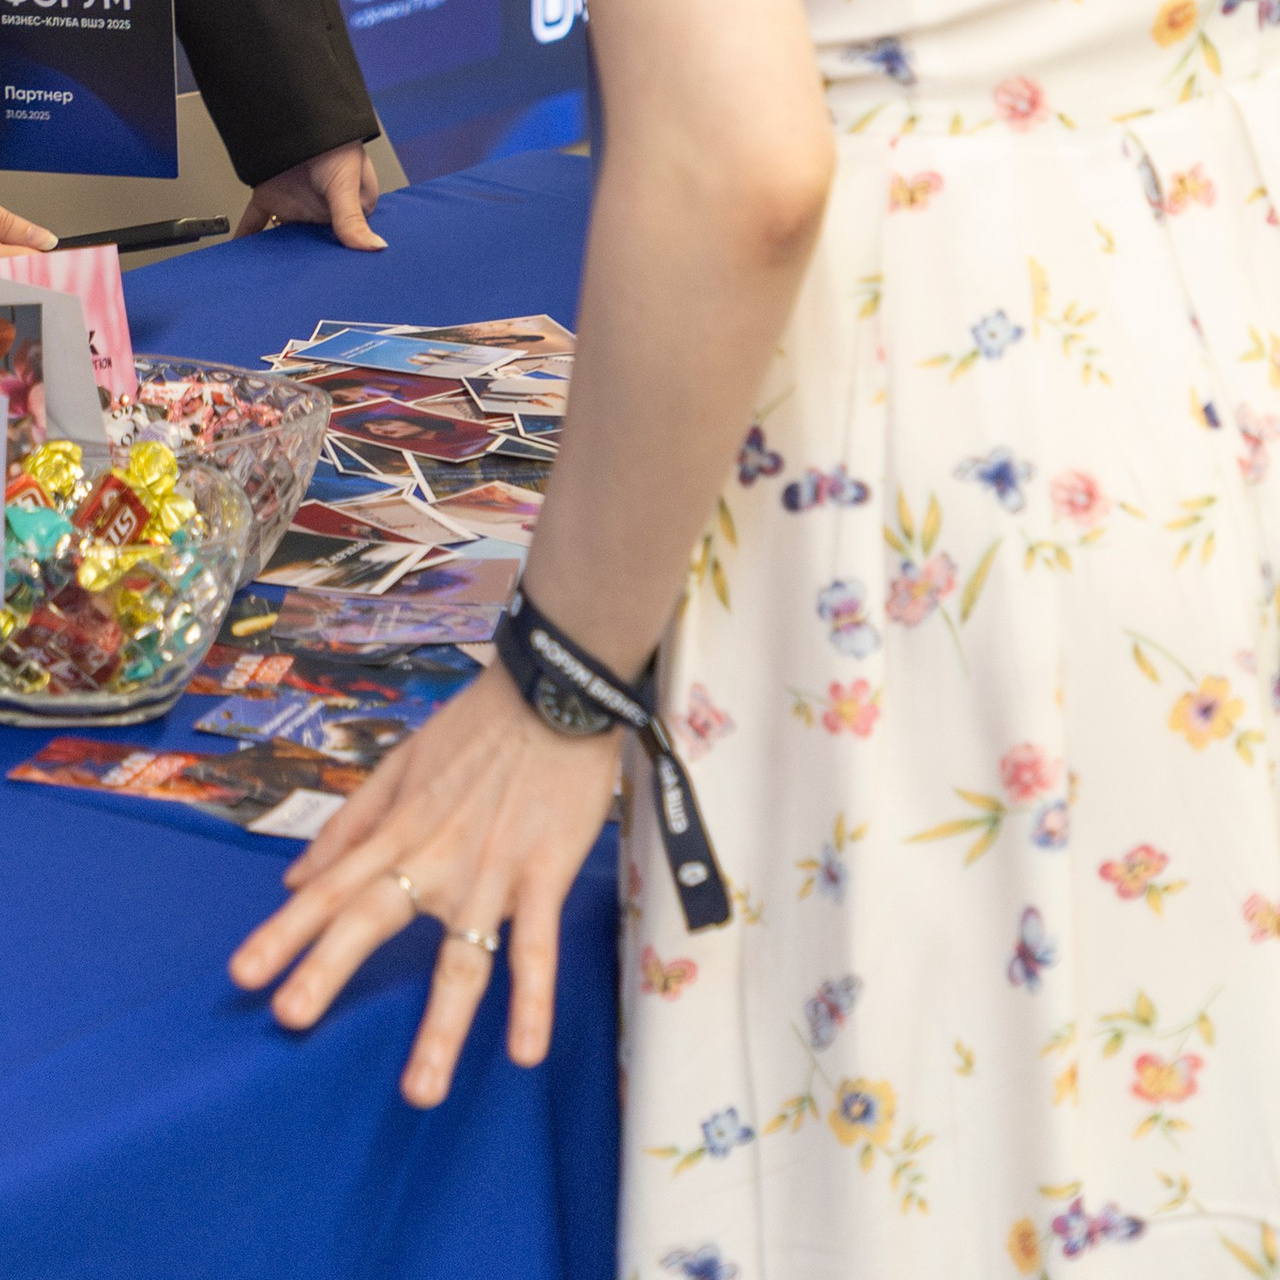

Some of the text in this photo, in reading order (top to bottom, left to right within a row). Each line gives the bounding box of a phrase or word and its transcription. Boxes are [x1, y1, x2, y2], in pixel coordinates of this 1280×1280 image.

[1, 14, 131, 30] БИЗНЕС-КЛУБА ВШЭ 2025
[4, 85, 74, 106] Партнер
[5, 109, 51, 121] 31.05.2025
